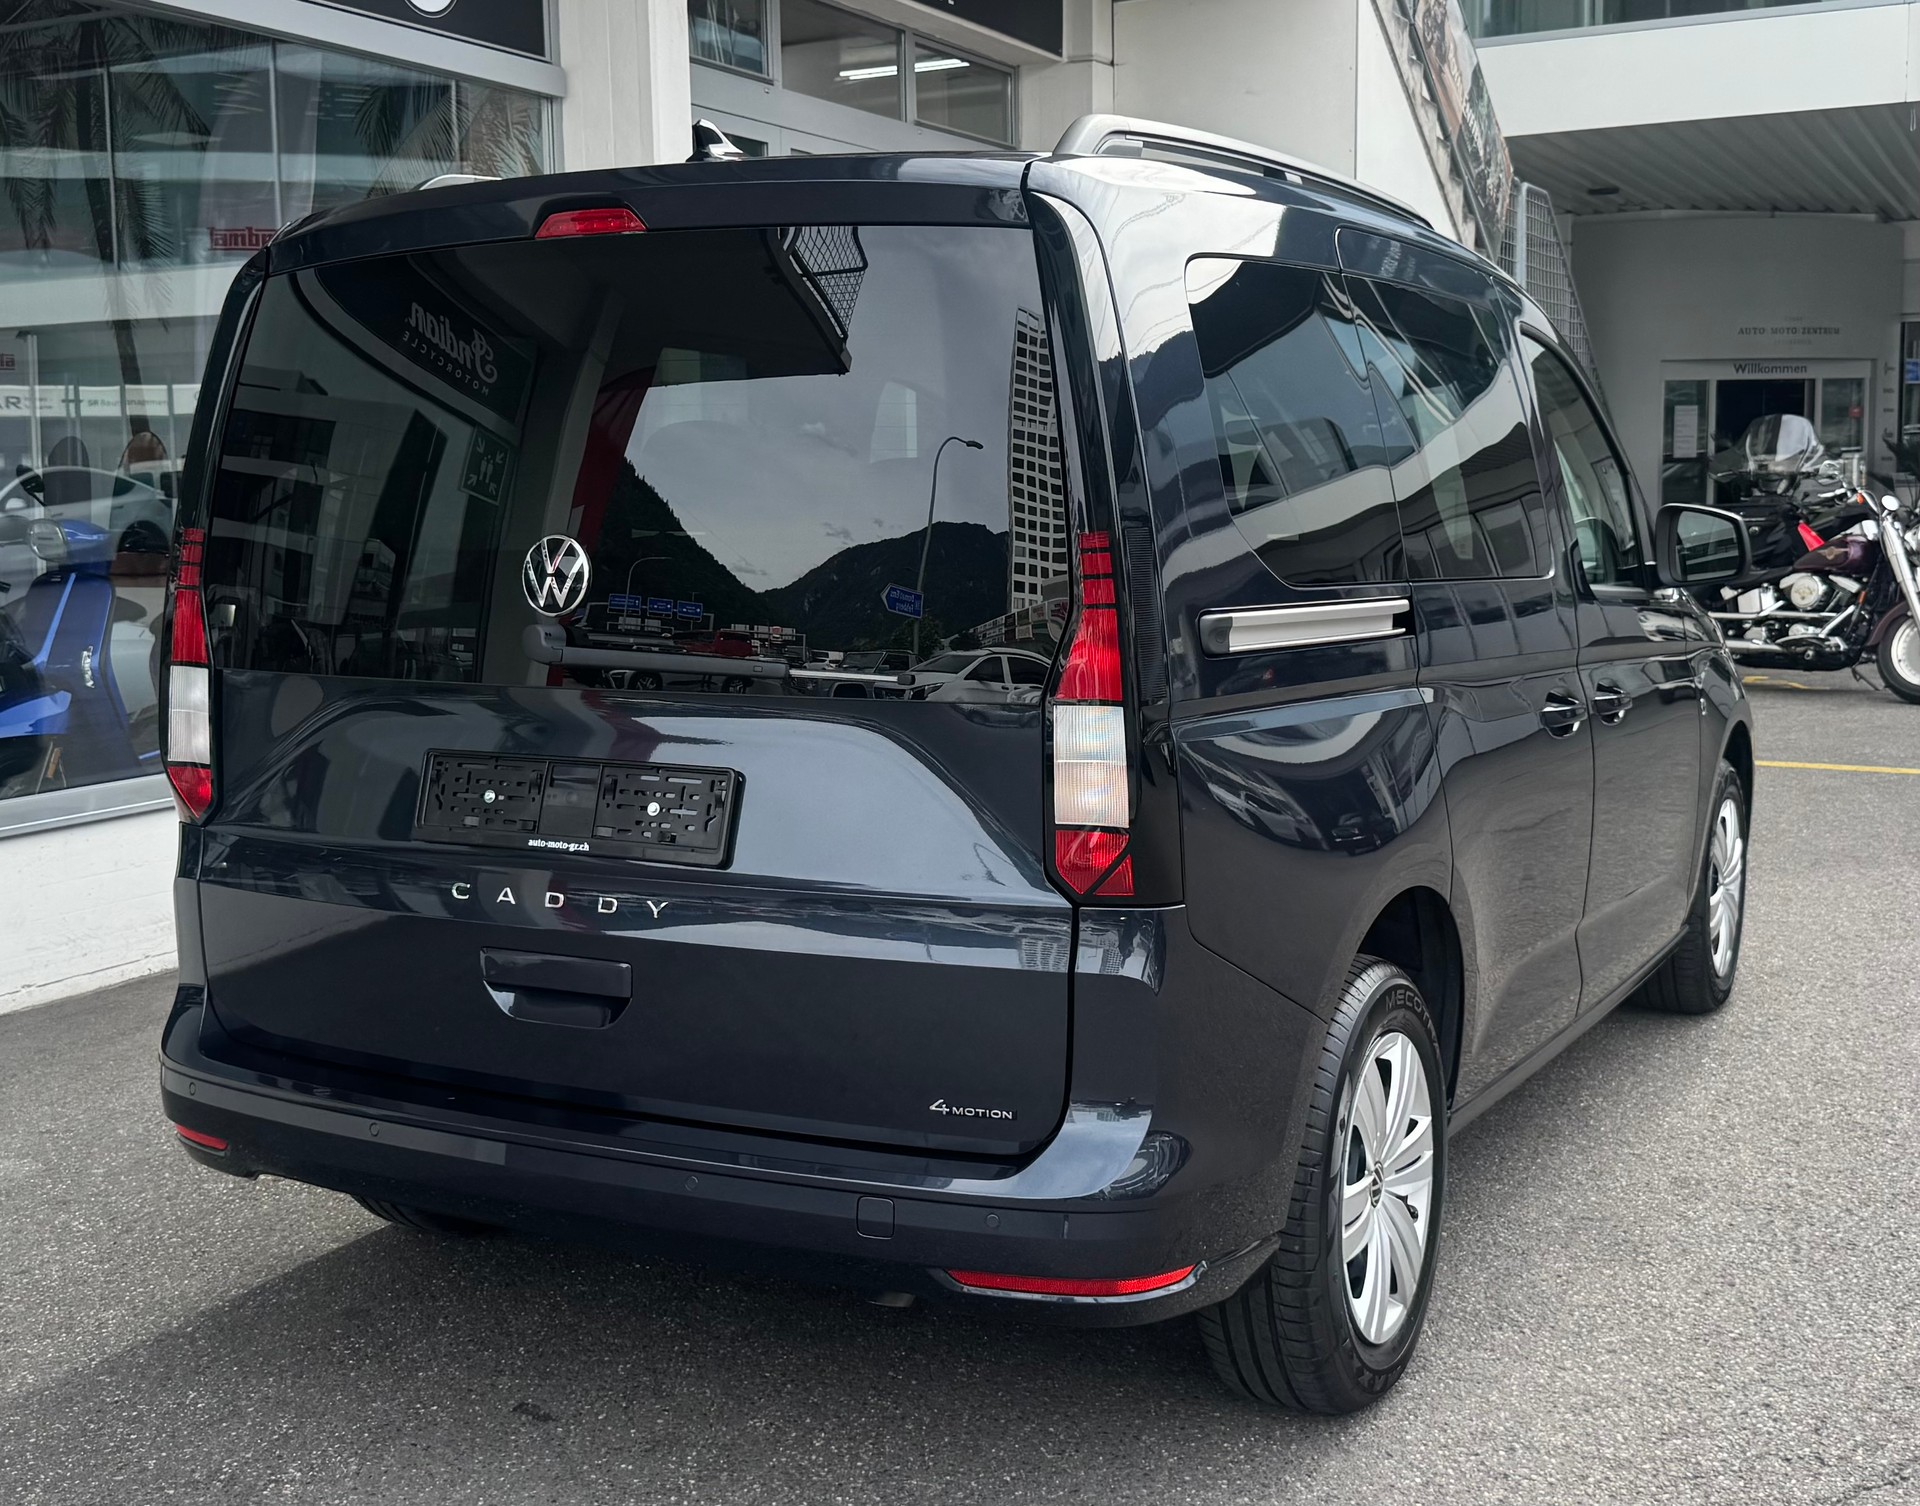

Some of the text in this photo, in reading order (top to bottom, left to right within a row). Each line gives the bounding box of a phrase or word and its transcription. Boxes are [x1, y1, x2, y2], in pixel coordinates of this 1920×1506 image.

[1737, 326, 1840, 335] AUTO MOTO ZENTRUM
[1733, 362, 1808, 375] Willkommen
[451, 882, 669, 919] CADDY
